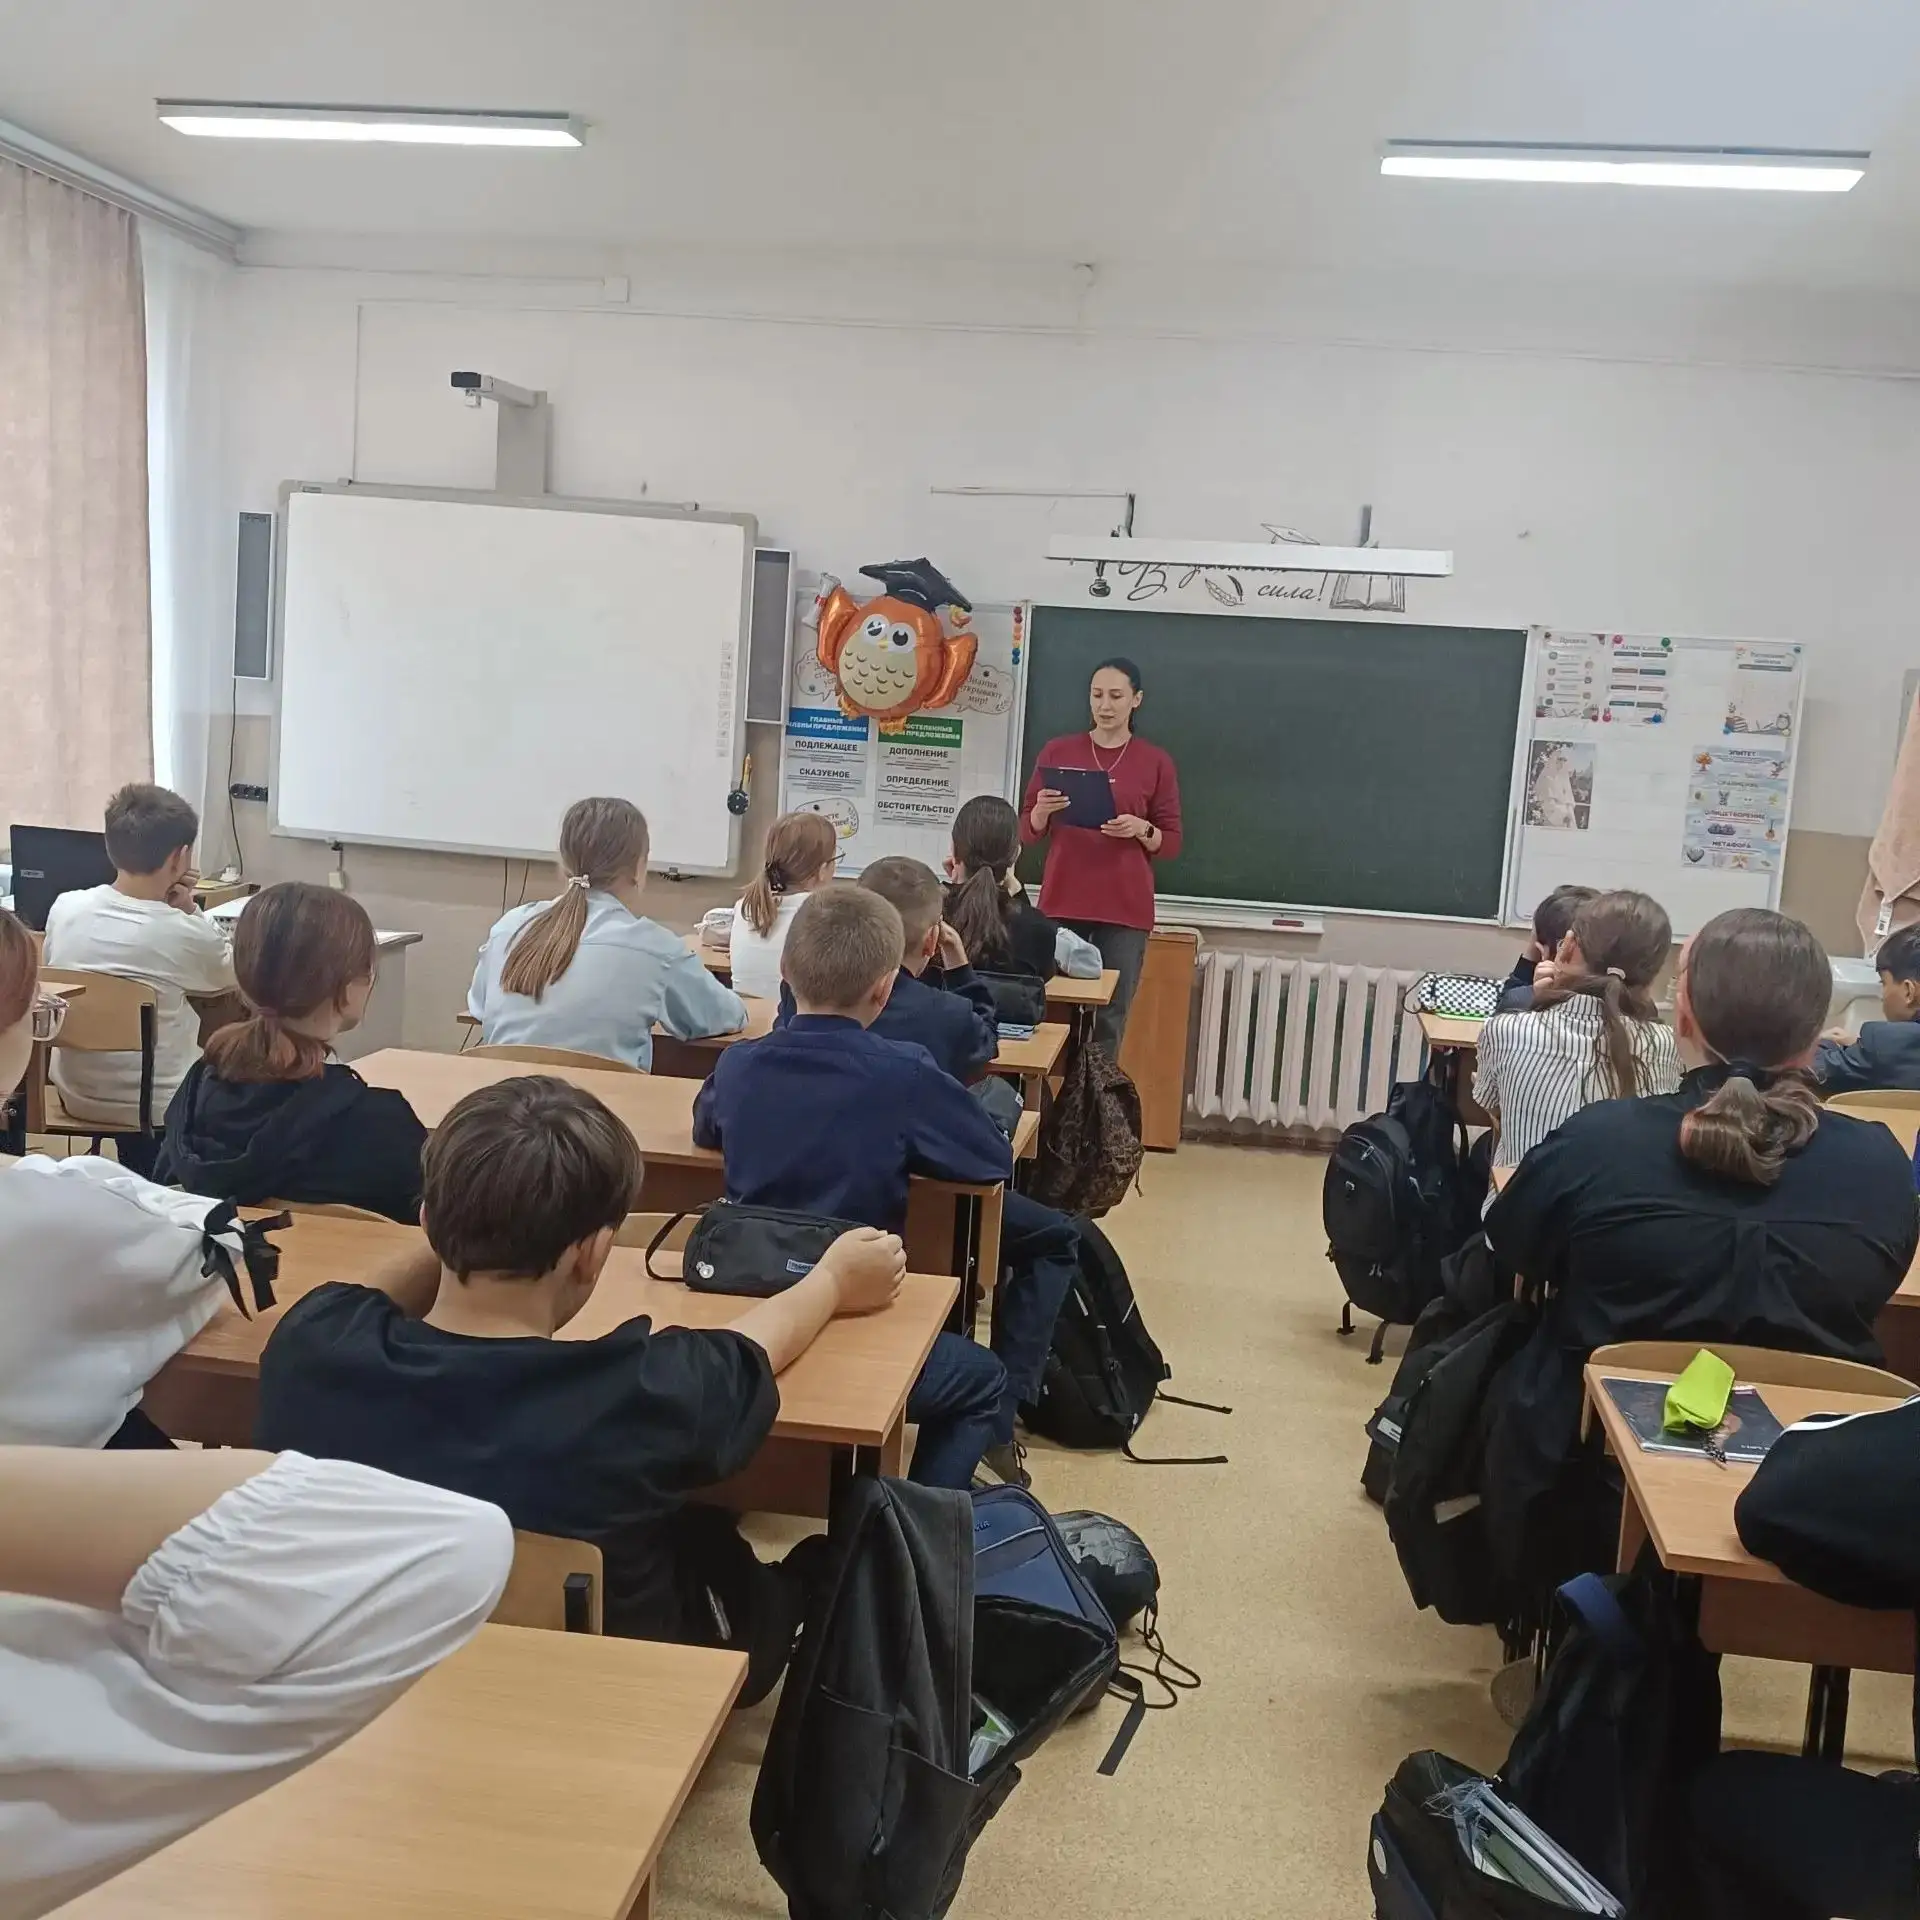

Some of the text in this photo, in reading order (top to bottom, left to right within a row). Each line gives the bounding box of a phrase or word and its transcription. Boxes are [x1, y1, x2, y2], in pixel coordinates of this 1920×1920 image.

[1257, 571, 1328, 601] сила!
[809, 716, 844, 724] ГЛАВНЫЕ
[812, 723, 867, 733] ПРЕДЛОЖЕНИЯ
[906, 730, 960, 740] ПРЕДЛОЖЕНИЯ
[795, 740, 858, 752] ПОДЛЕЖАЩЕЕ
[889, 747, 949, 758] ДОПОЛНЕНИЕ
[799, 768, 850, 778] СКАЗУЕМОЕ
[886, 775, 950, 787] ОПРЕДЕЛЕНИЕ
[877, 801, 955, 814] ОБСТОЯТЕЛЬСТВО
[1711, 840, 1752, 849] МЕТАФОРА
